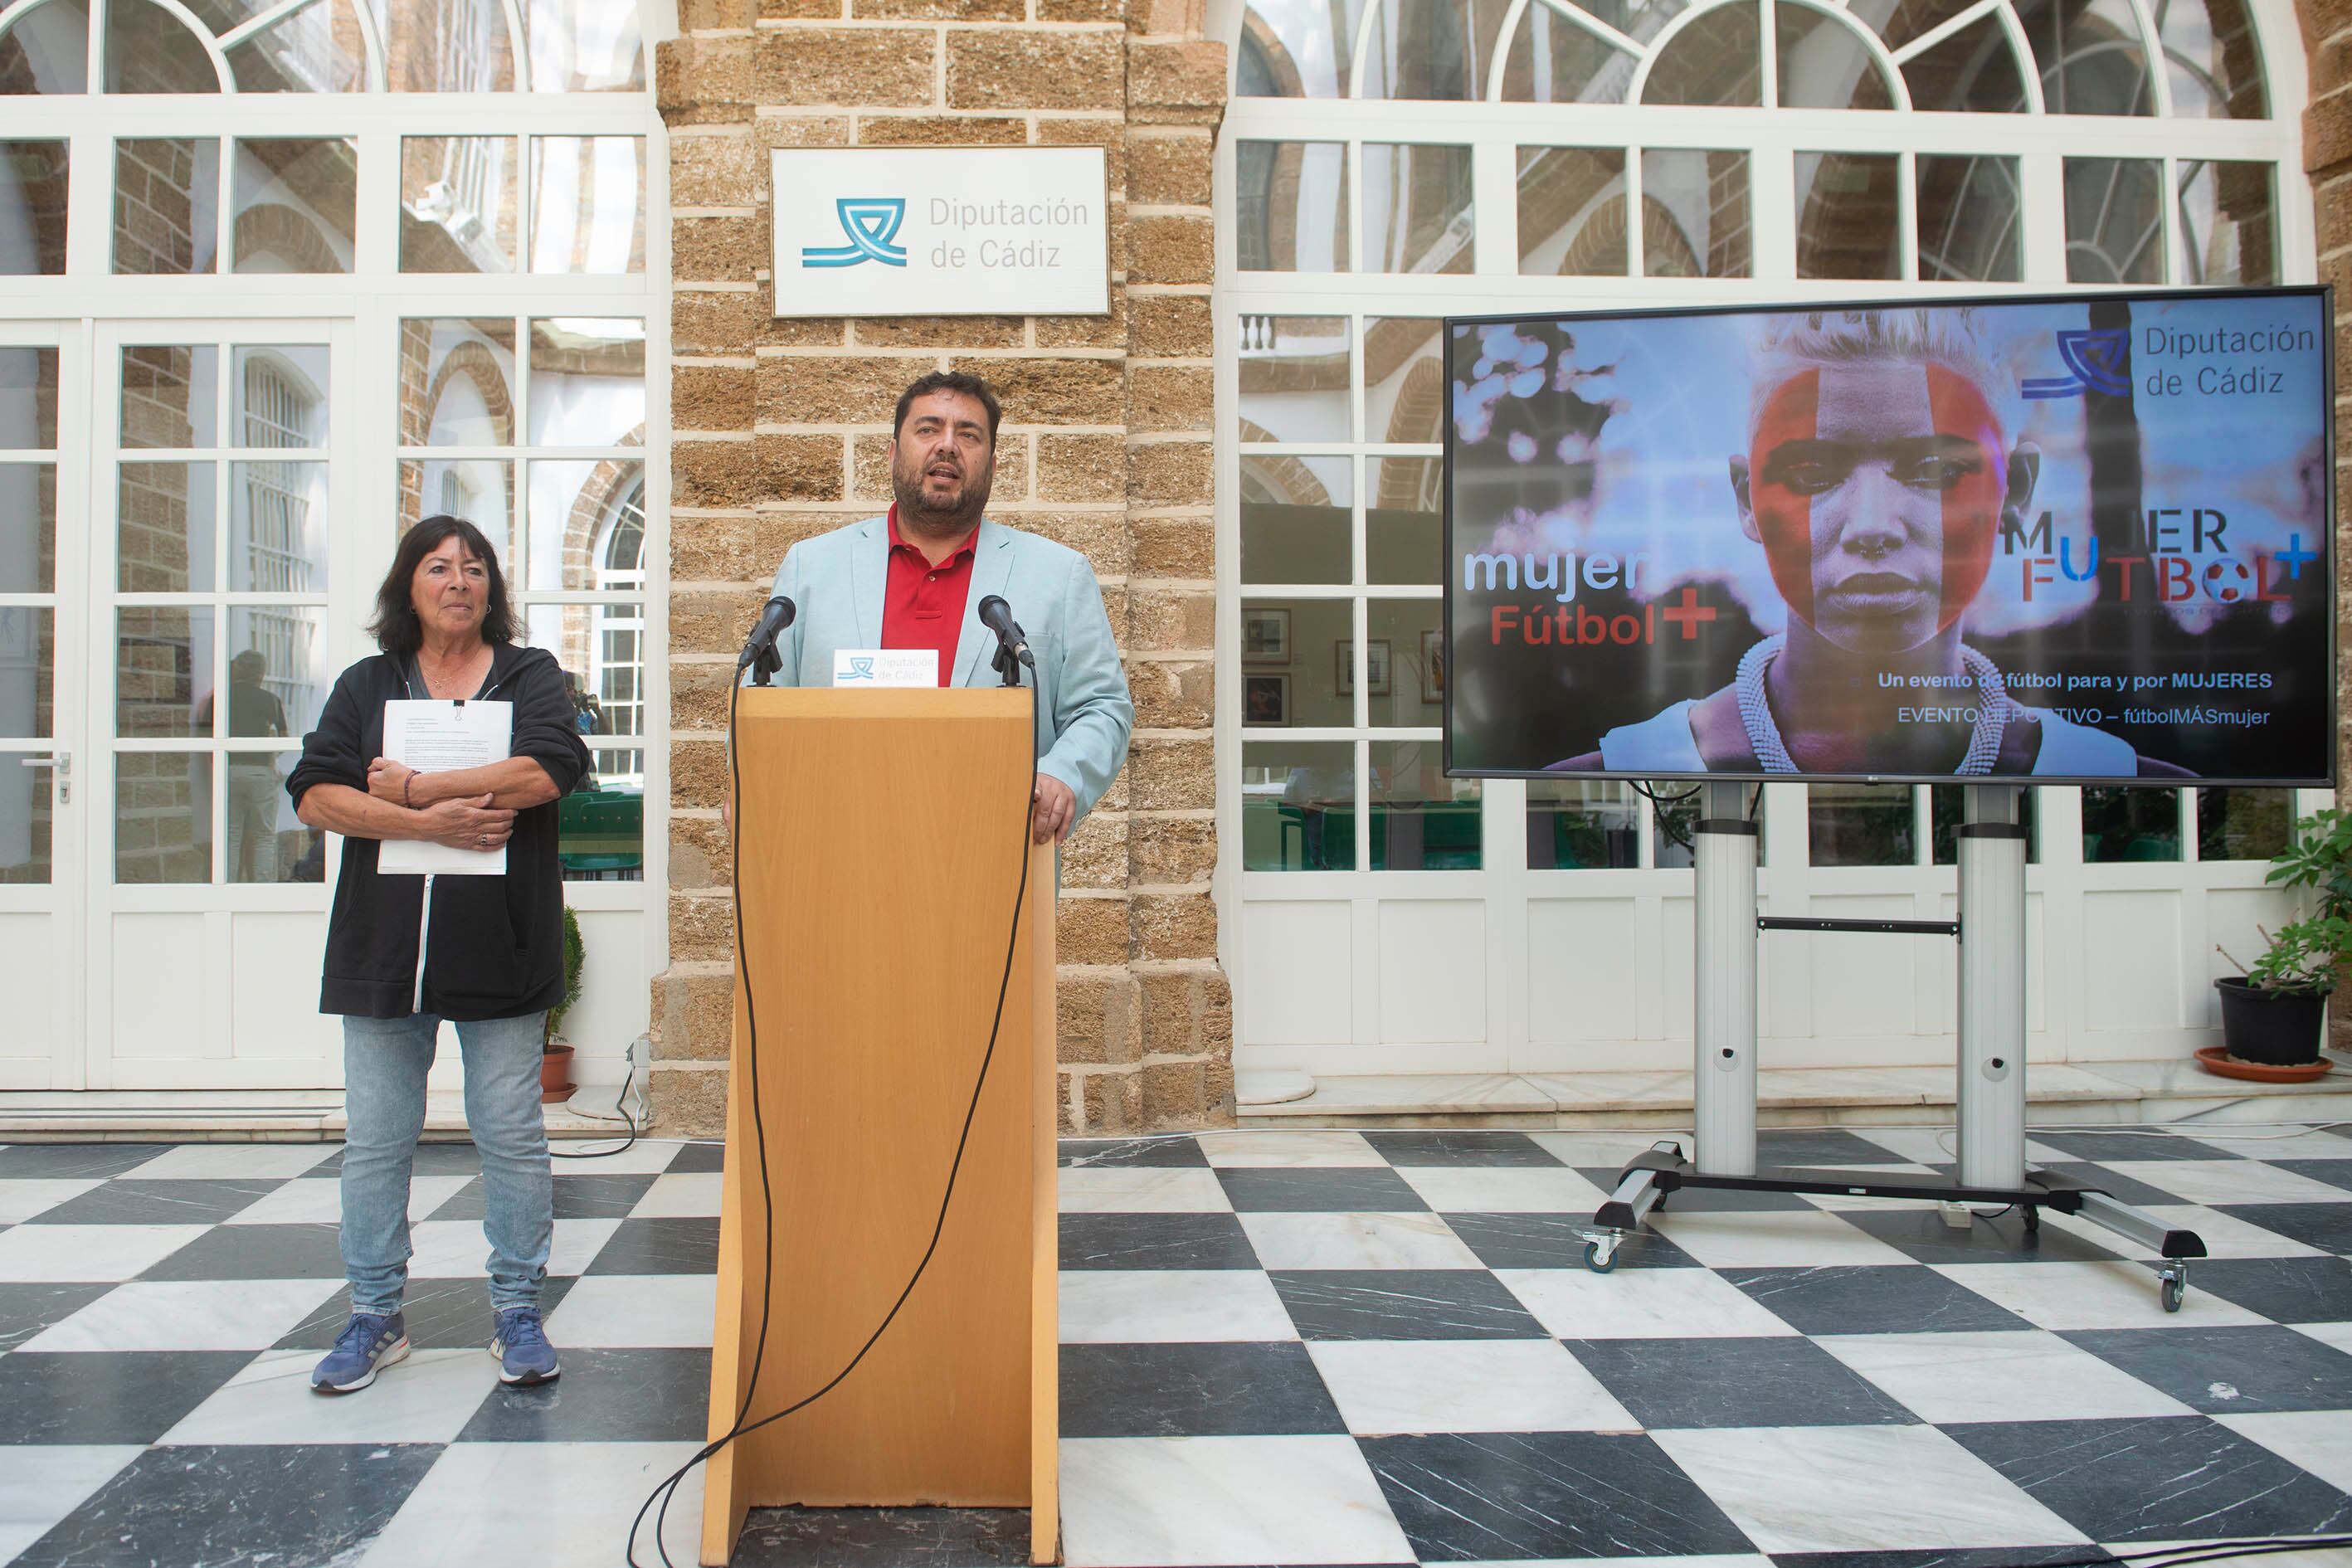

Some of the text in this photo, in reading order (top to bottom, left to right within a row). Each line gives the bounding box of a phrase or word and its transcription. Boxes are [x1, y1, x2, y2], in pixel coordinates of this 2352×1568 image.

[929, 197, 1088, 231] Diputación
[930, 239, 1061, 268] de Cádiz
[2145, 325, 2315, 360] Diputación
[2146, 367, 2284, 397] de Cádiz
[1463, 551, 1654, 603] mujer
[879, 656, 935, 668] Diputación
[1878, 673, 1904, 688] Un
[1908, 675, 1973, 688] evento
[2005, 672, 2062, 688] fútbol
[2067, 675, 2112, 692] para
[2116, 675, 2128, 692] y
[2133, 675, 2167, 692] por
[2171, 672, 2272, 688] MUJERES
[1898, 707, 1979, 723] EVENTO
[1983, 707, 2102, 724] DEPOTIVO
[2123, 705, 2271, 728] fútbolMÁSmujer
